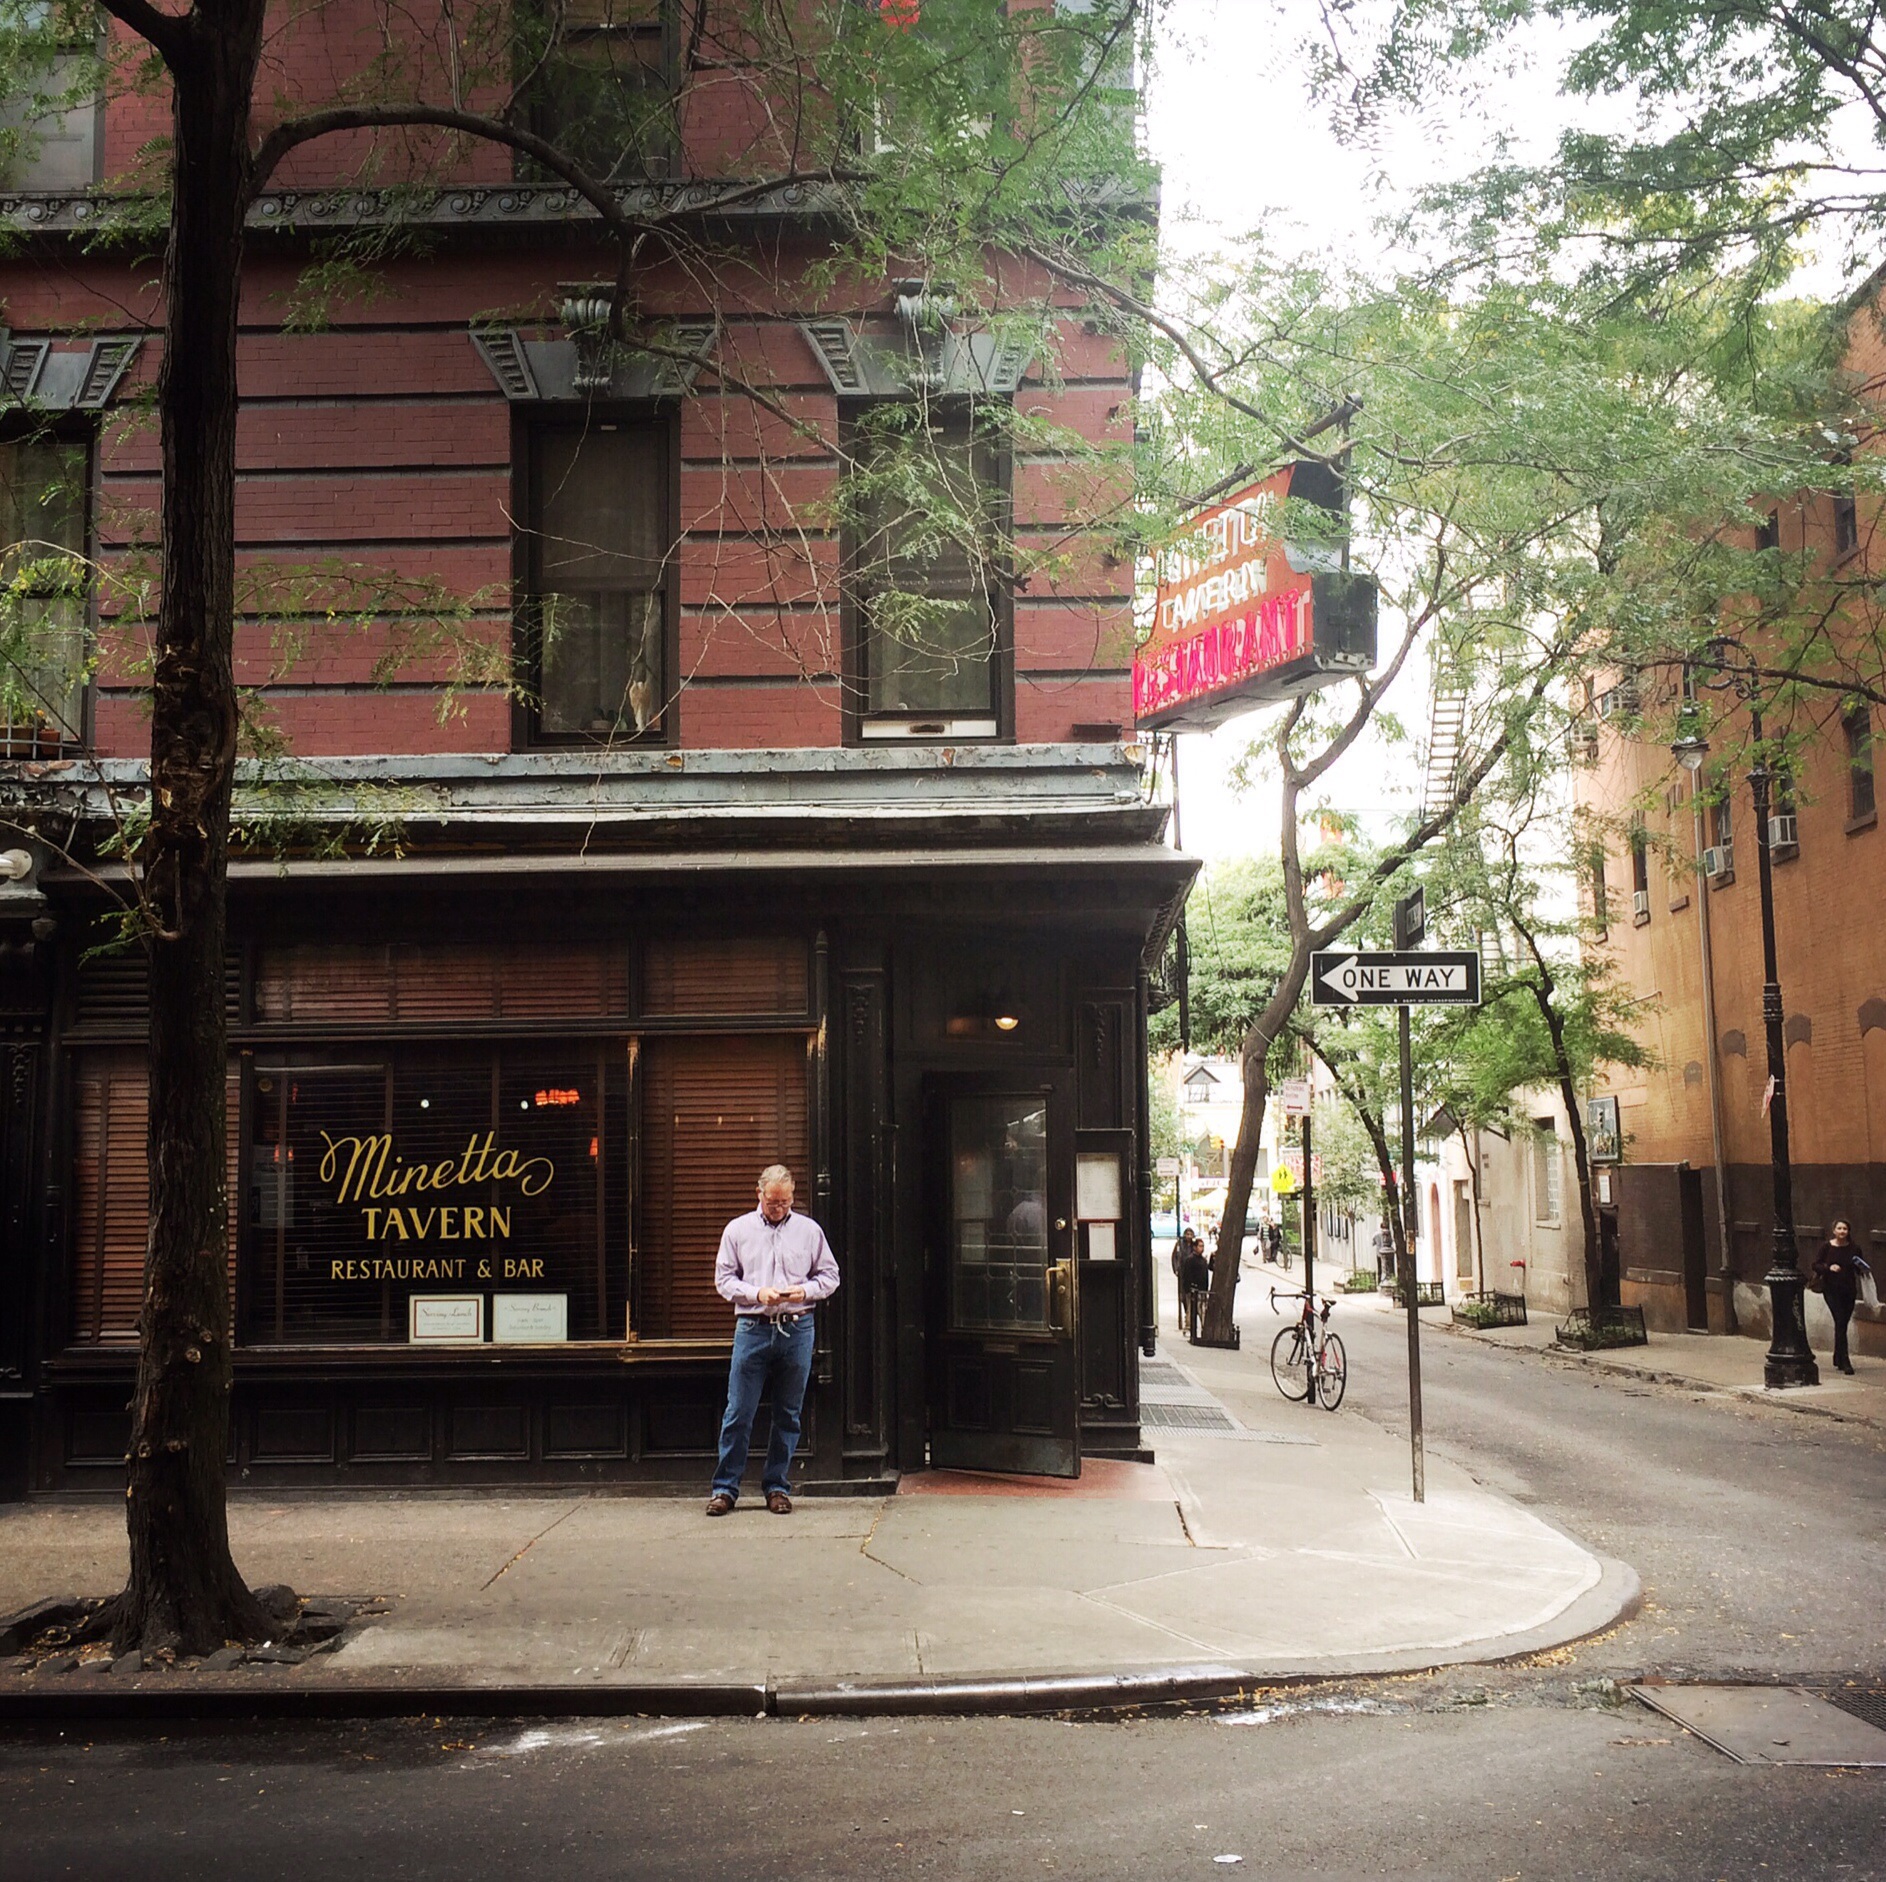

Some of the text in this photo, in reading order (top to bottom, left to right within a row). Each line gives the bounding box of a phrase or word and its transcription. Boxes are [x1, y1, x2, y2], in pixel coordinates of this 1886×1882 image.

[1160, 557, 1268, 633] TAVERN
[1342, 968, 1455, 988] ONE WAY
[320, 1130, 554, 1203] Minetta
[361, 1206, 511, 1240] TAVERN
[331, 1258, 545, 1280] RESTAURANT & BAR
